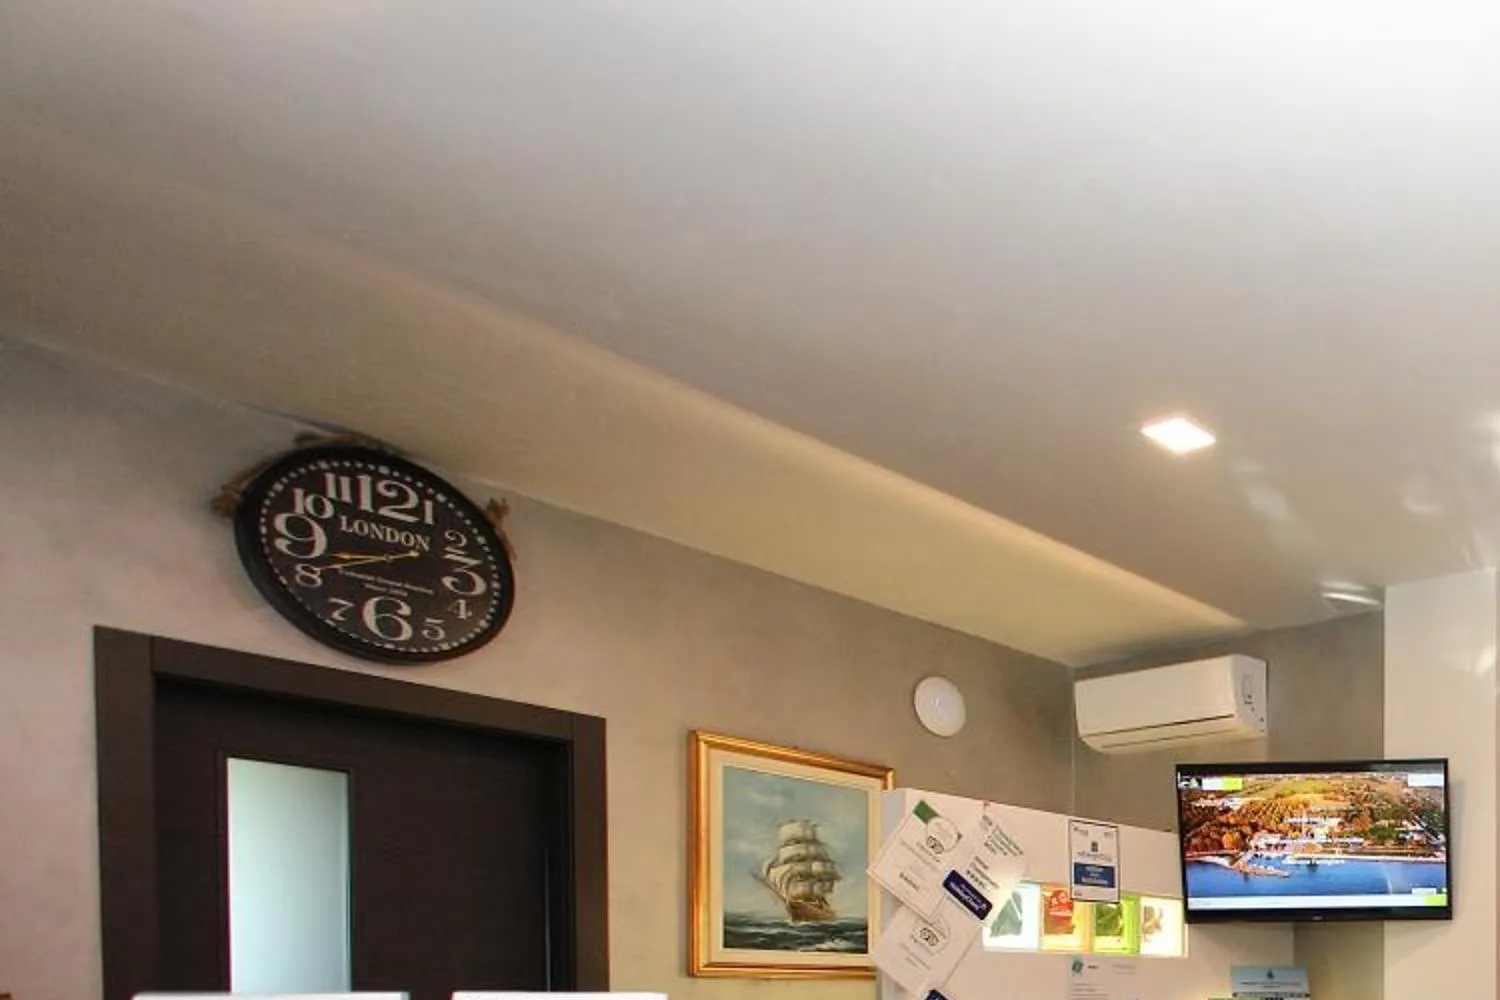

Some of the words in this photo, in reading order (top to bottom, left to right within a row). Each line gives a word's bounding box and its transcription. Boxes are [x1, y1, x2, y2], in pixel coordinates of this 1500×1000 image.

[325, 472, 352, 503] 11
[358, 475, 420, 523] 12
[293, 488, 334, 519] 10
[423, 500, 435, 525] 1
[273, 512, 328, 559] 9
[339, 515, 431, 552] LONDON
[443, 529, 468, 555] 2
[294, 563, 323, 588] 8
[441, 553, 487, 596] 3
[328, 597, 355, 621] 7
[362, 595, 412, 642] 6
[447, 599, 473, 620] 4
[422, 618, 446, 641] 5
